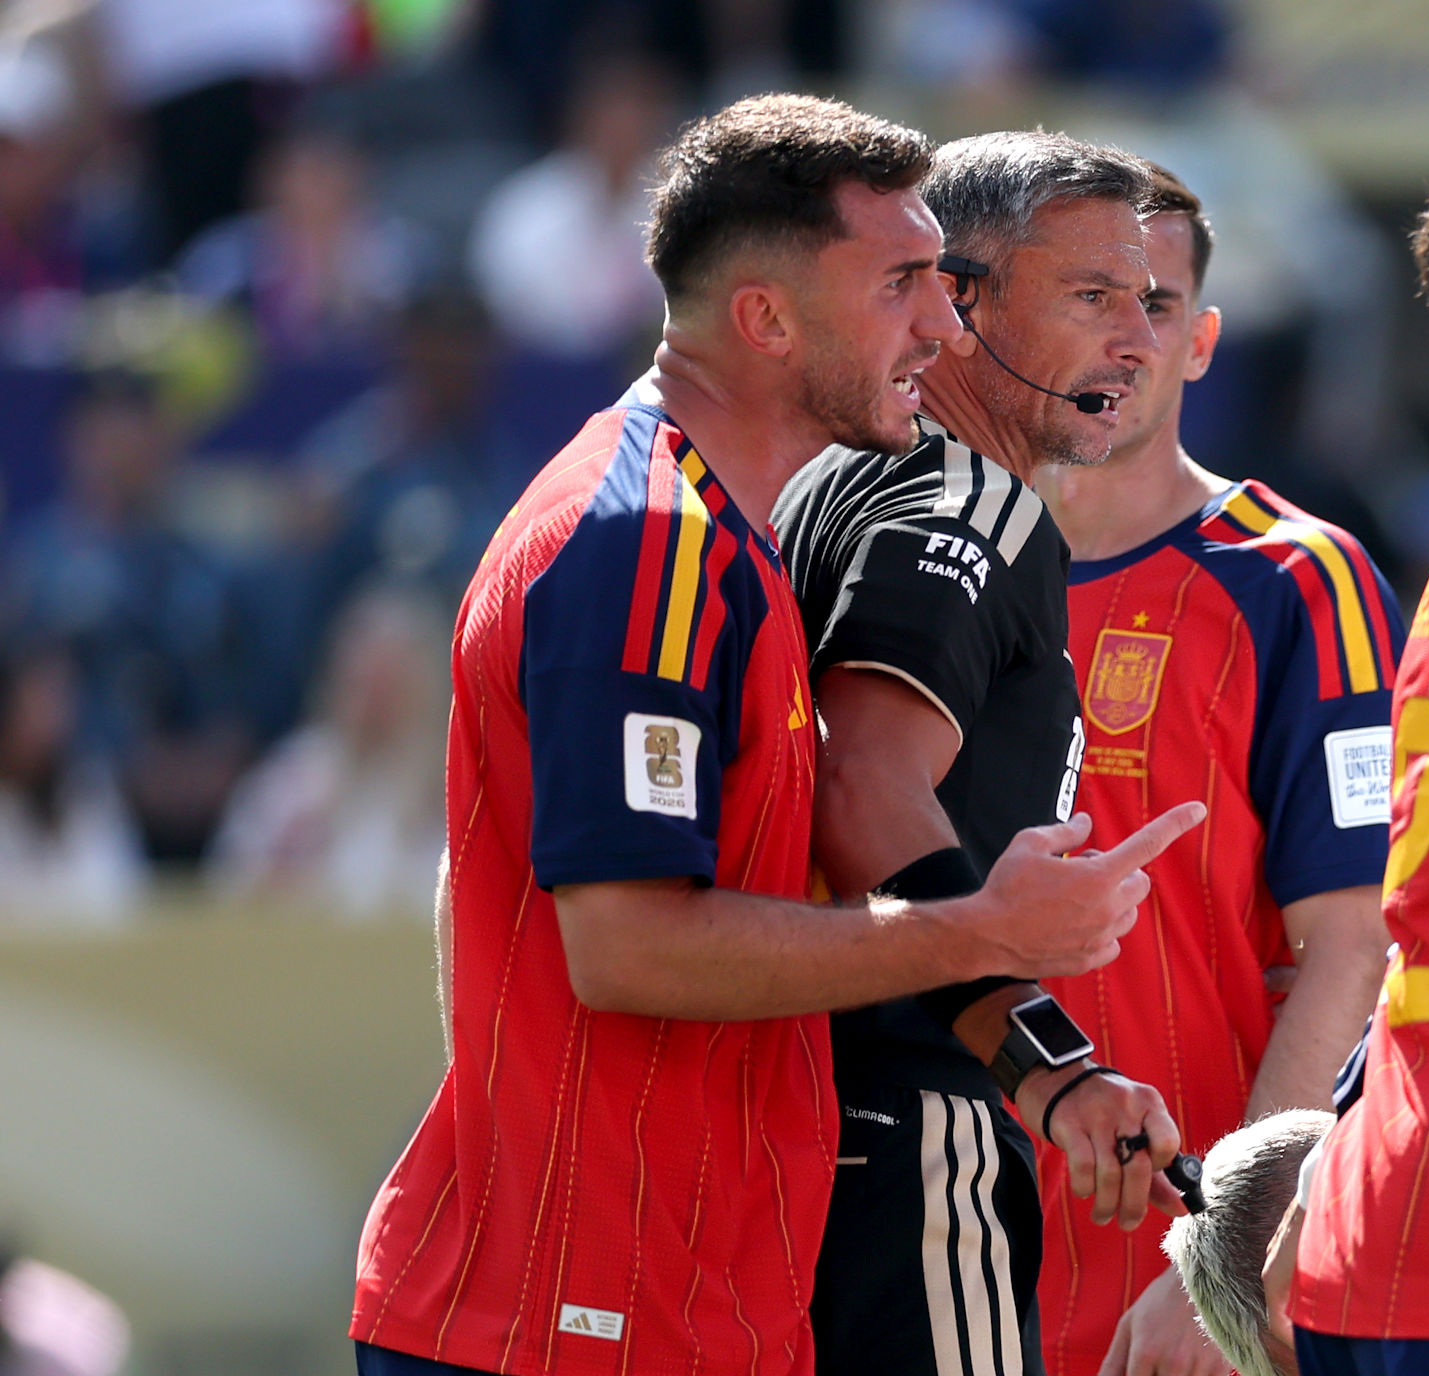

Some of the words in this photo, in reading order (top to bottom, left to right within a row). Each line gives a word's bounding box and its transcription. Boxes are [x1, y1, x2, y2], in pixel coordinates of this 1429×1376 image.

[917, 559, 961, 581] TEAM
[960, 575, 979, 605] ONE
[925, 532, 990, 589] FIFA
[1345, 759, 1391, 780] UNITE
